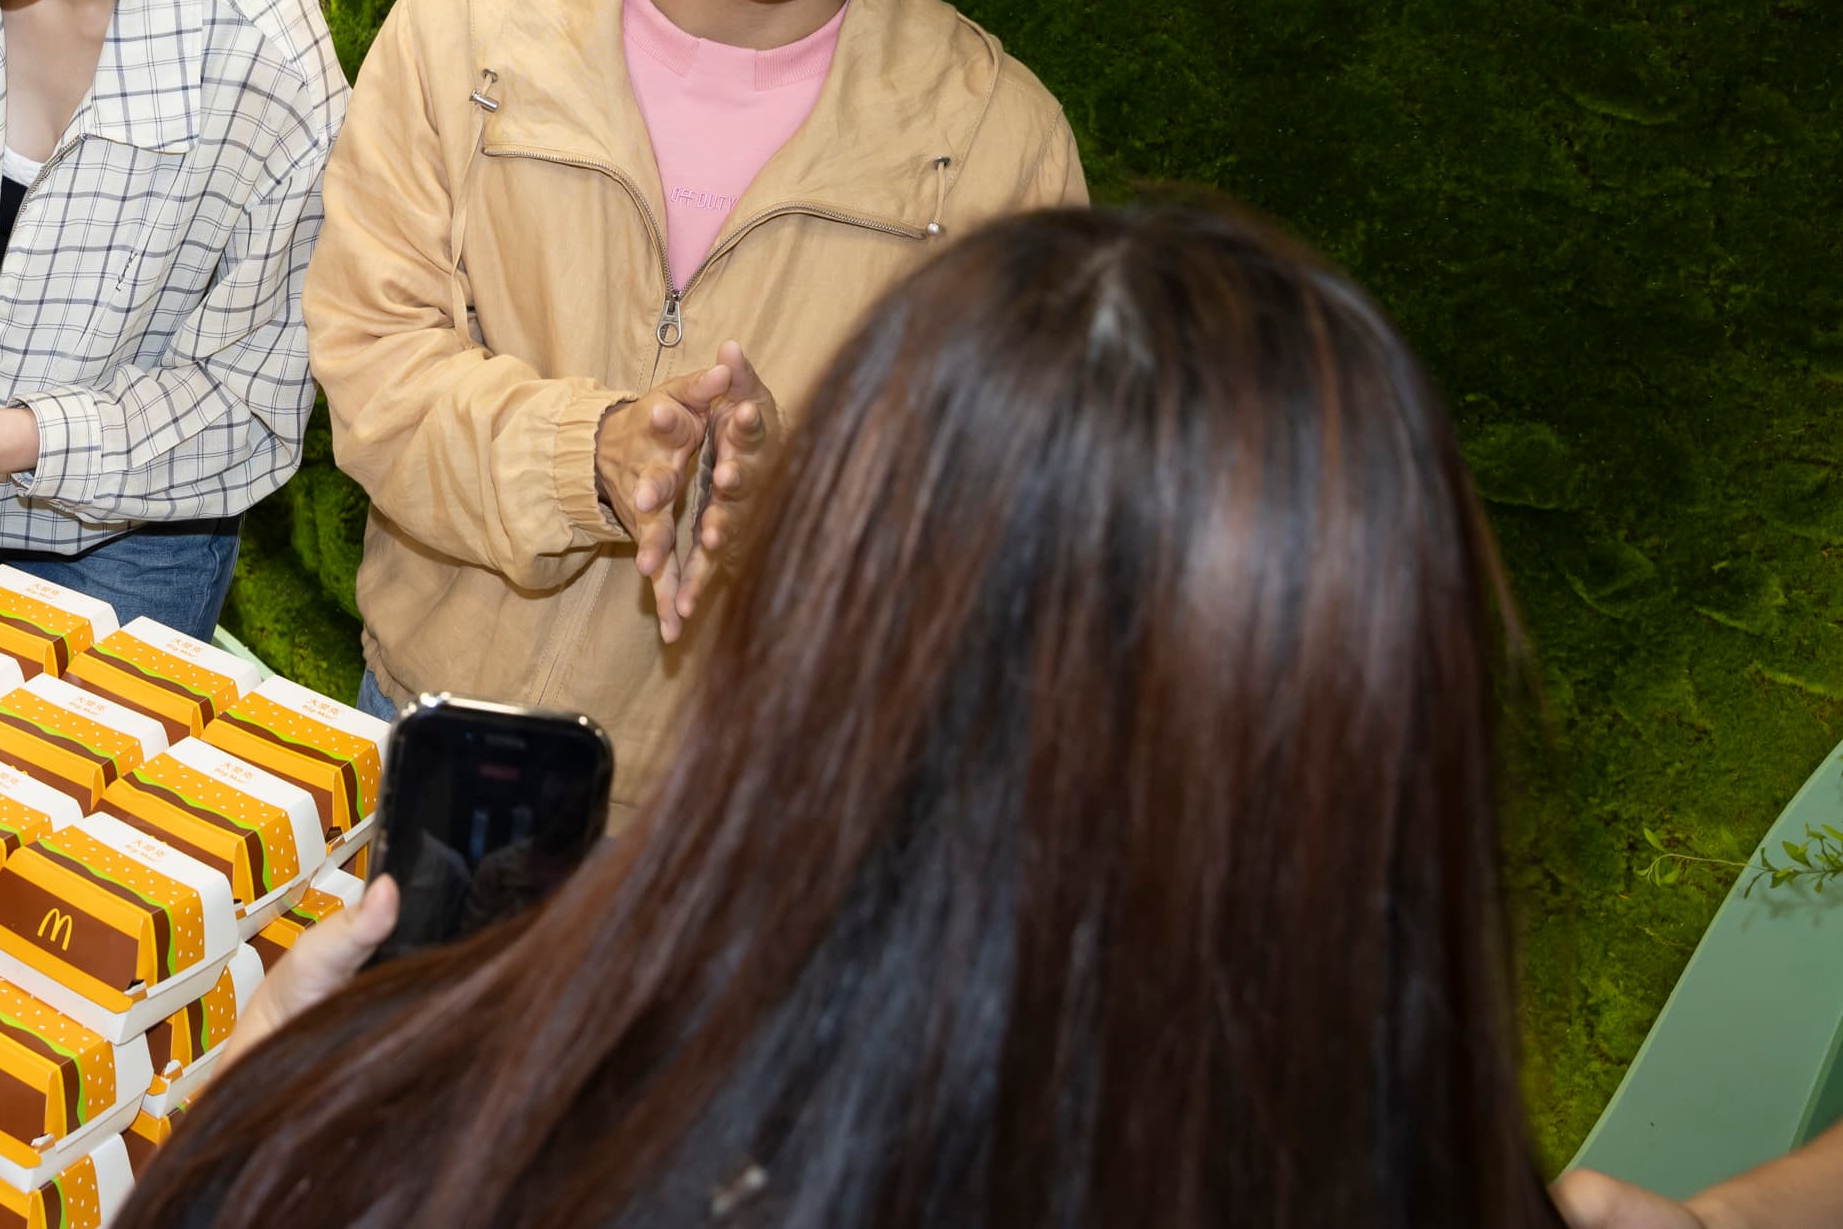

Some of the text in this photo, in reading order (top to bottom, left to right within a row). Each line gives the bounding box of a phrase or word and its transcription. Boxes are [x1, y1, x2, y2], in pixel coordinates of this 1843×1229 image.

[669, 186, 738, 211] OFF DUTY
[37, 907, 73, 952] M
